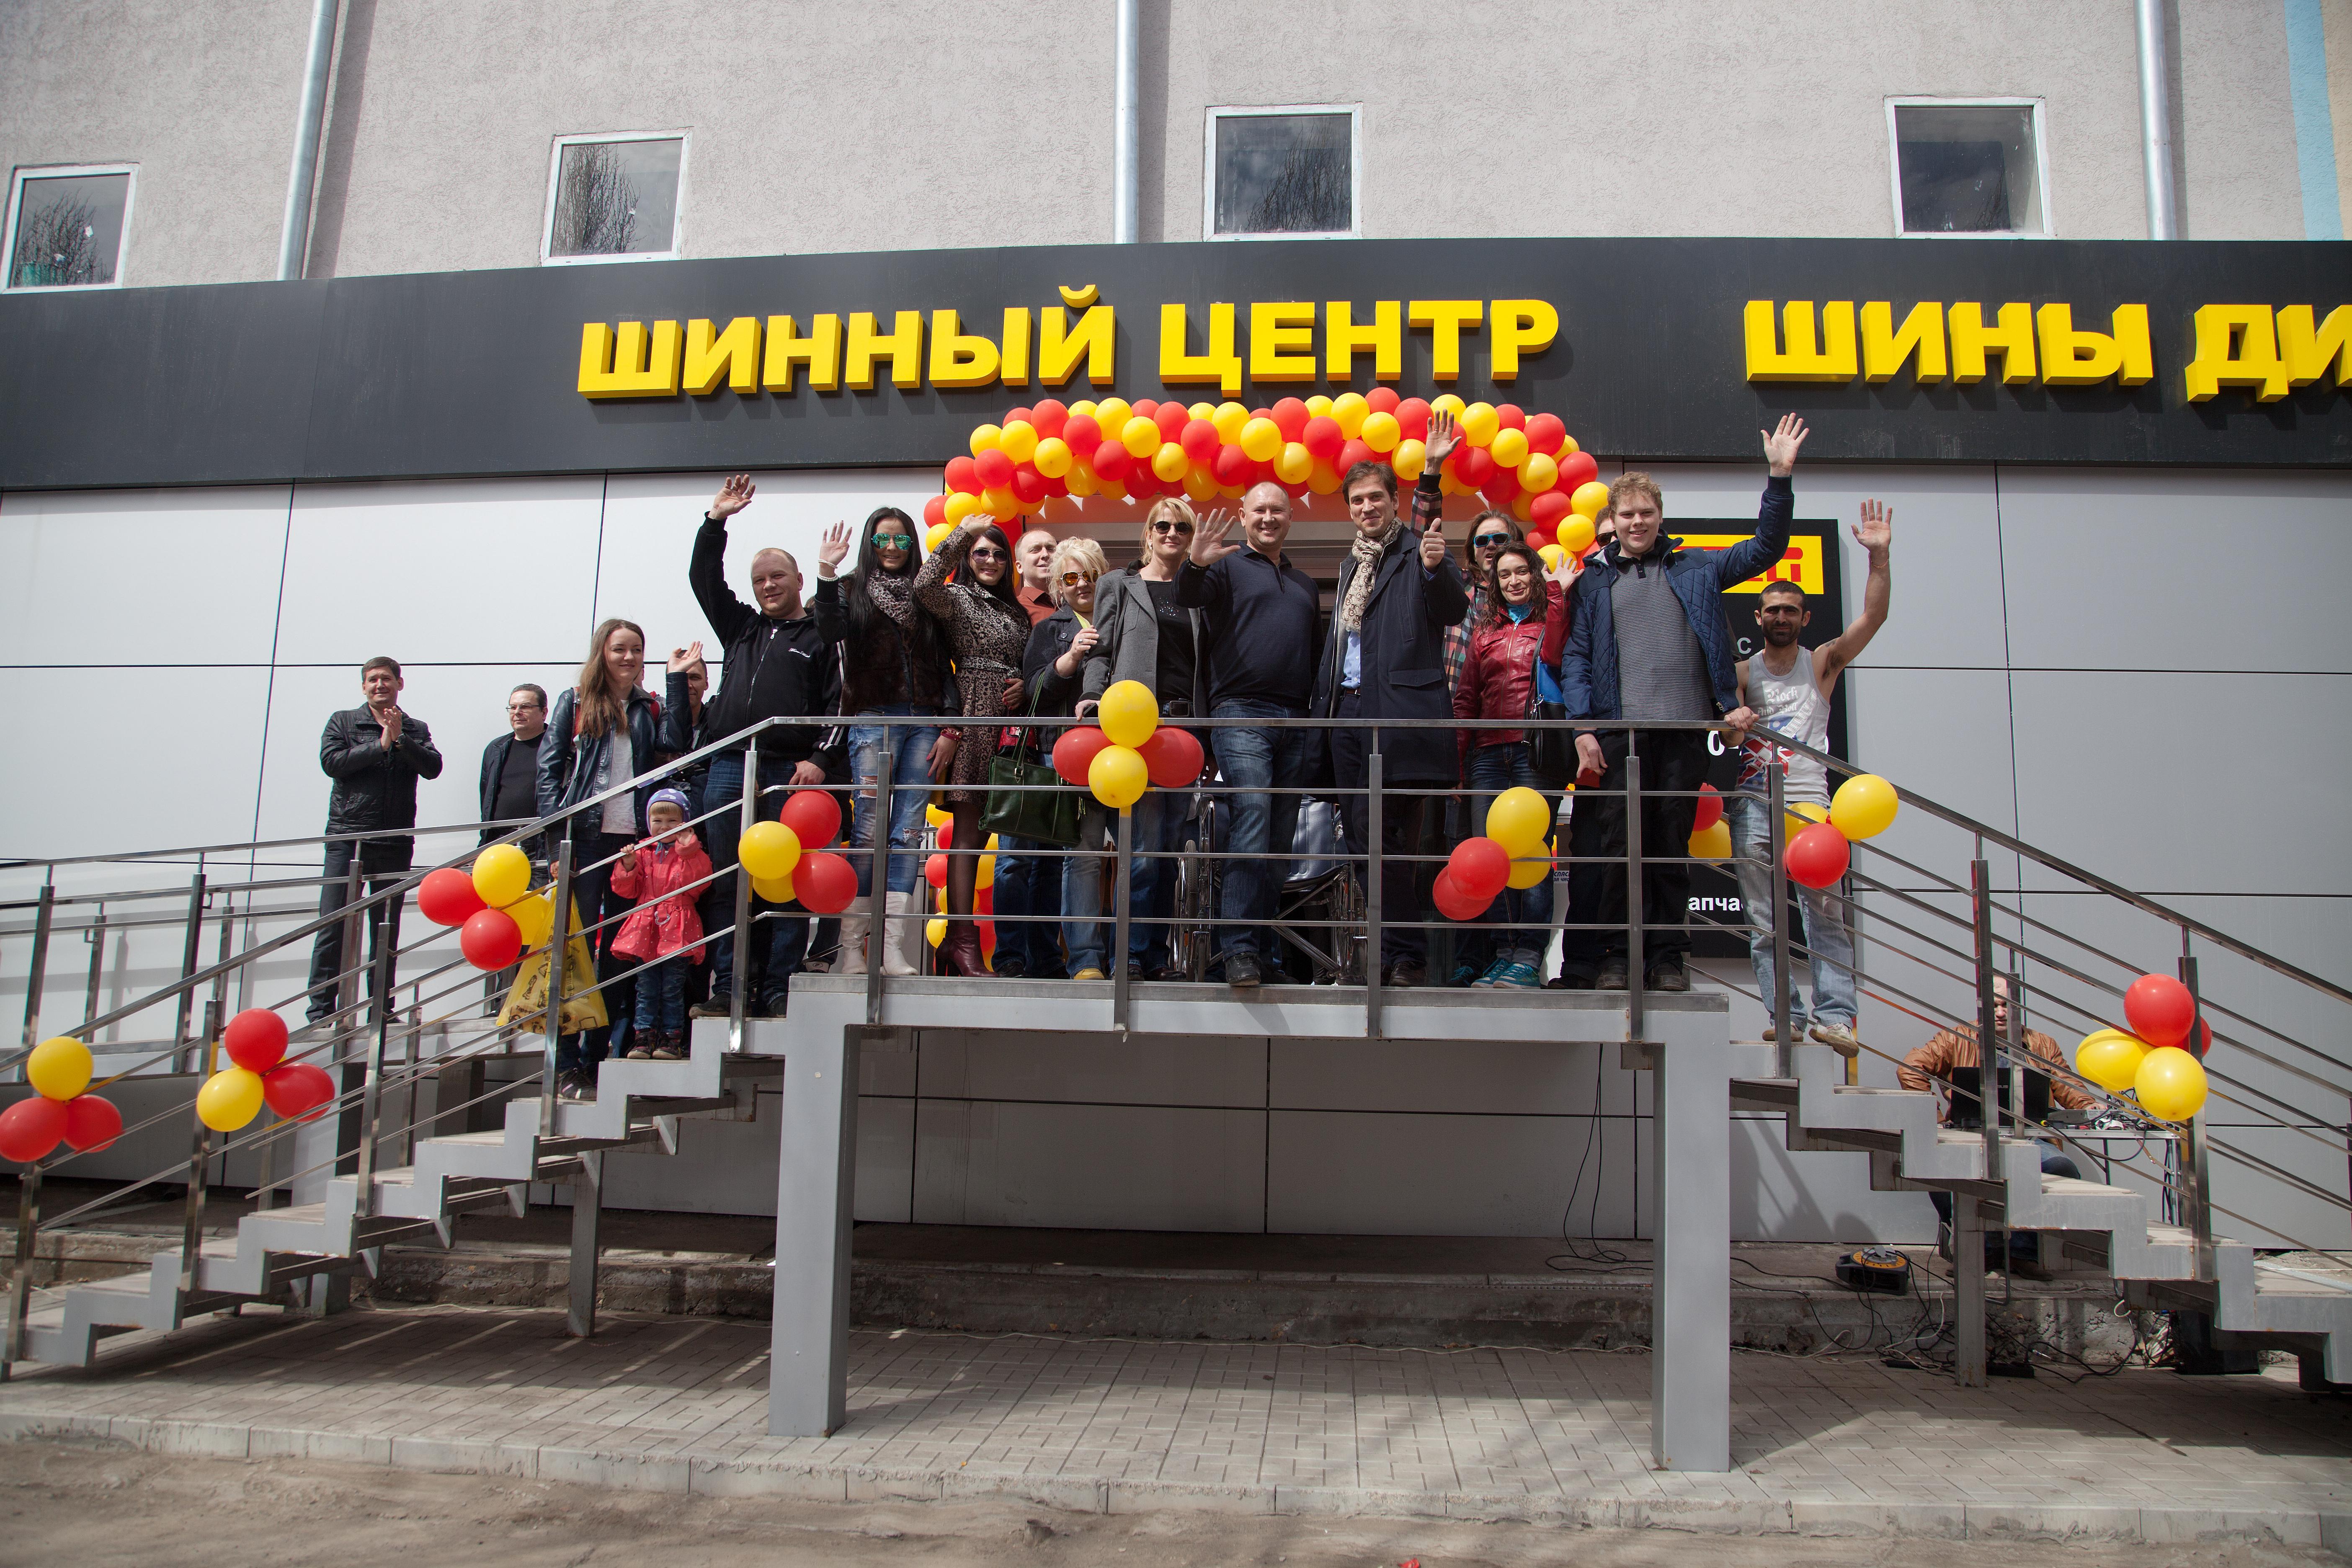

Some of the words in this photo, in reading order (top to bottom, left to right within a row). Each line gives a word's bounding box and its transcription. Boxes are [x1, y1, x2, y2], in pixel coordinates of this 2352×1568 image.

[578, 285, 1115, 399] ШИННЫЙ
[1159, 299, 1559, 397] ЦЕНТР
[1744, 300, 2153, 386] ШИНЫ
[1765, 686, 1798, 705] Rock
[1688, 897, 1743, 911] апча
